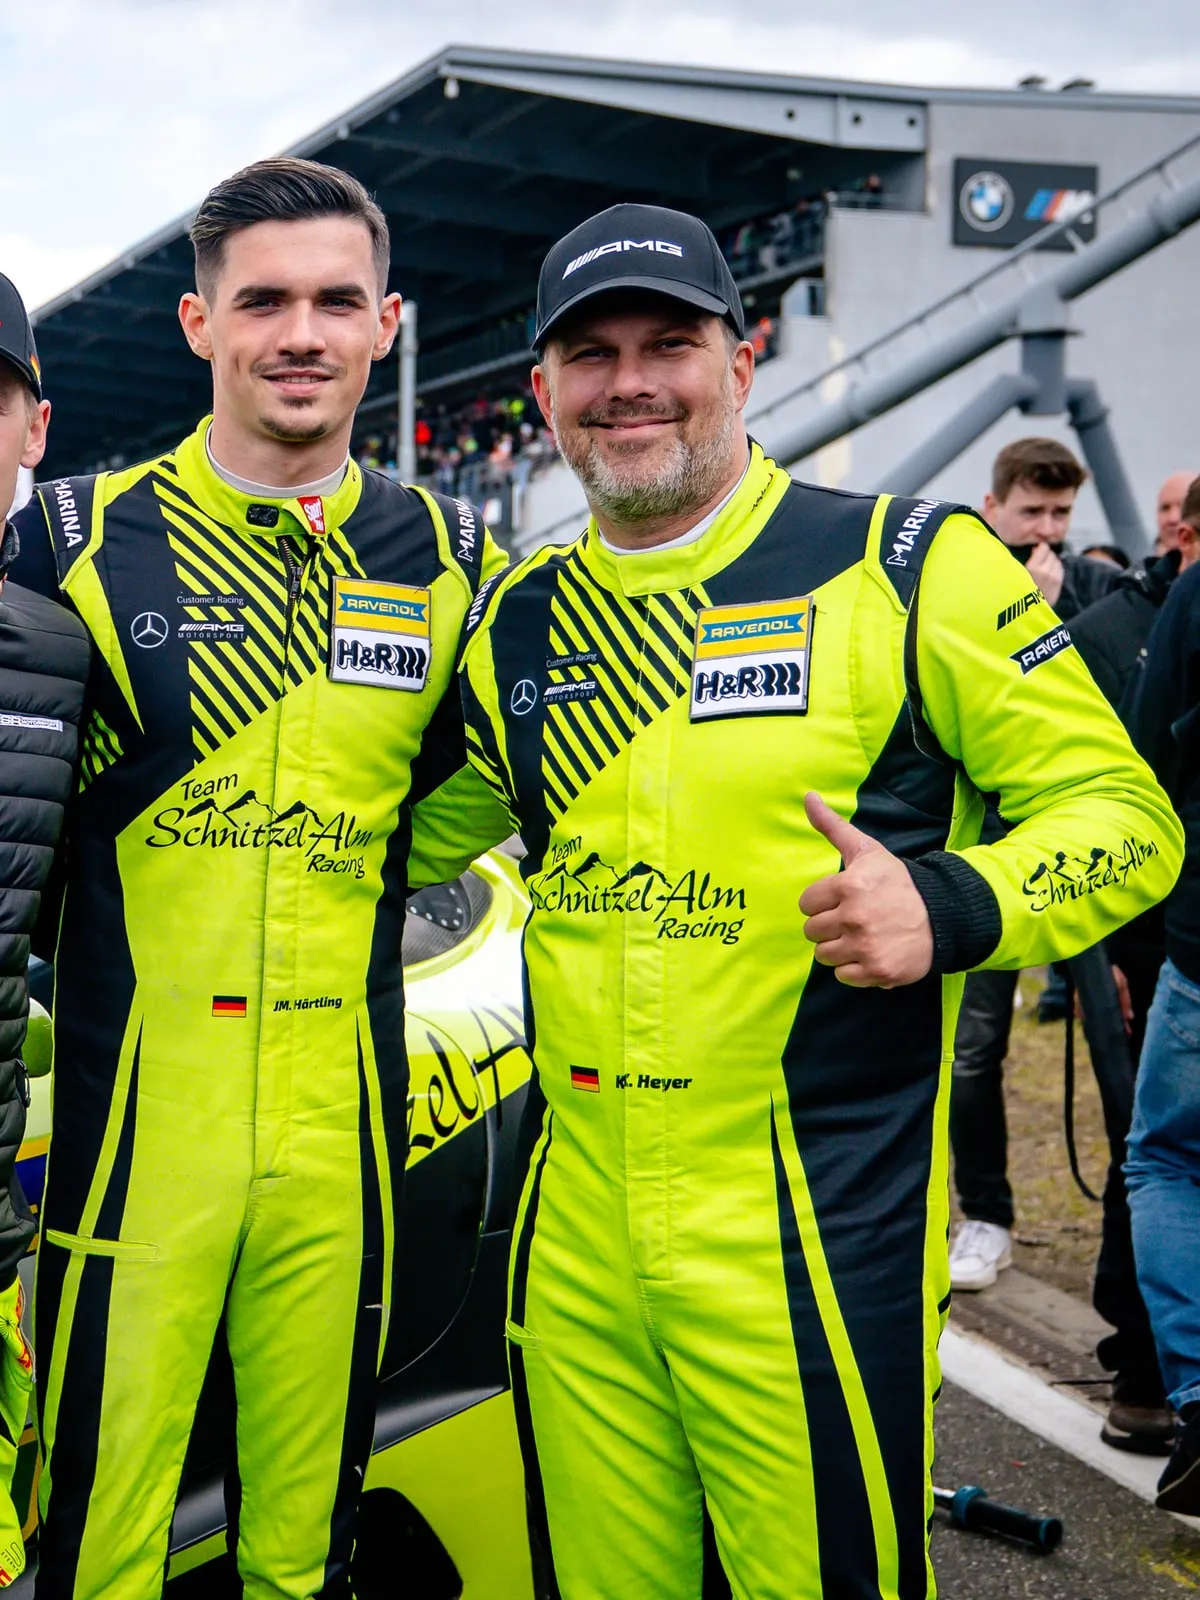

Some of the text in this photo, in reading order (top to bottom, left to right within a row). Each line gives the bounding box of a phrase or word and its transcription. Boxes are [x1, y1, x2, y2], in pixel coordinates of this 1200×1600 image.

[592, 240, 683, 261] AMG
[52, 477, 83, 548] MARINA
[452, 498, 476, 562] MARIN
[176, 595, 245, 606] Customer Racing
[346, 598, 420, 618] RAVENOL
[177, 632, 244, 640] MOTORSPORT
[710, 618, 795, 639] RAVENOL
[336, 638, 397, 676] H&R
[545, 653, 598, 668] Customer Racing
[694, 666, 763, 703] H&R
[543, 690, 595, 702] MOTORSPORT
[181, 772, 238, 801] Team
[551, 834, 582, 867] Team
[306, 853, 365, 879] Racing
[657, 915, 745, 945] Racing
[273, 996, 343, 1012] JM. Härtling
[636, 1074, 693, 1093] Heyer
